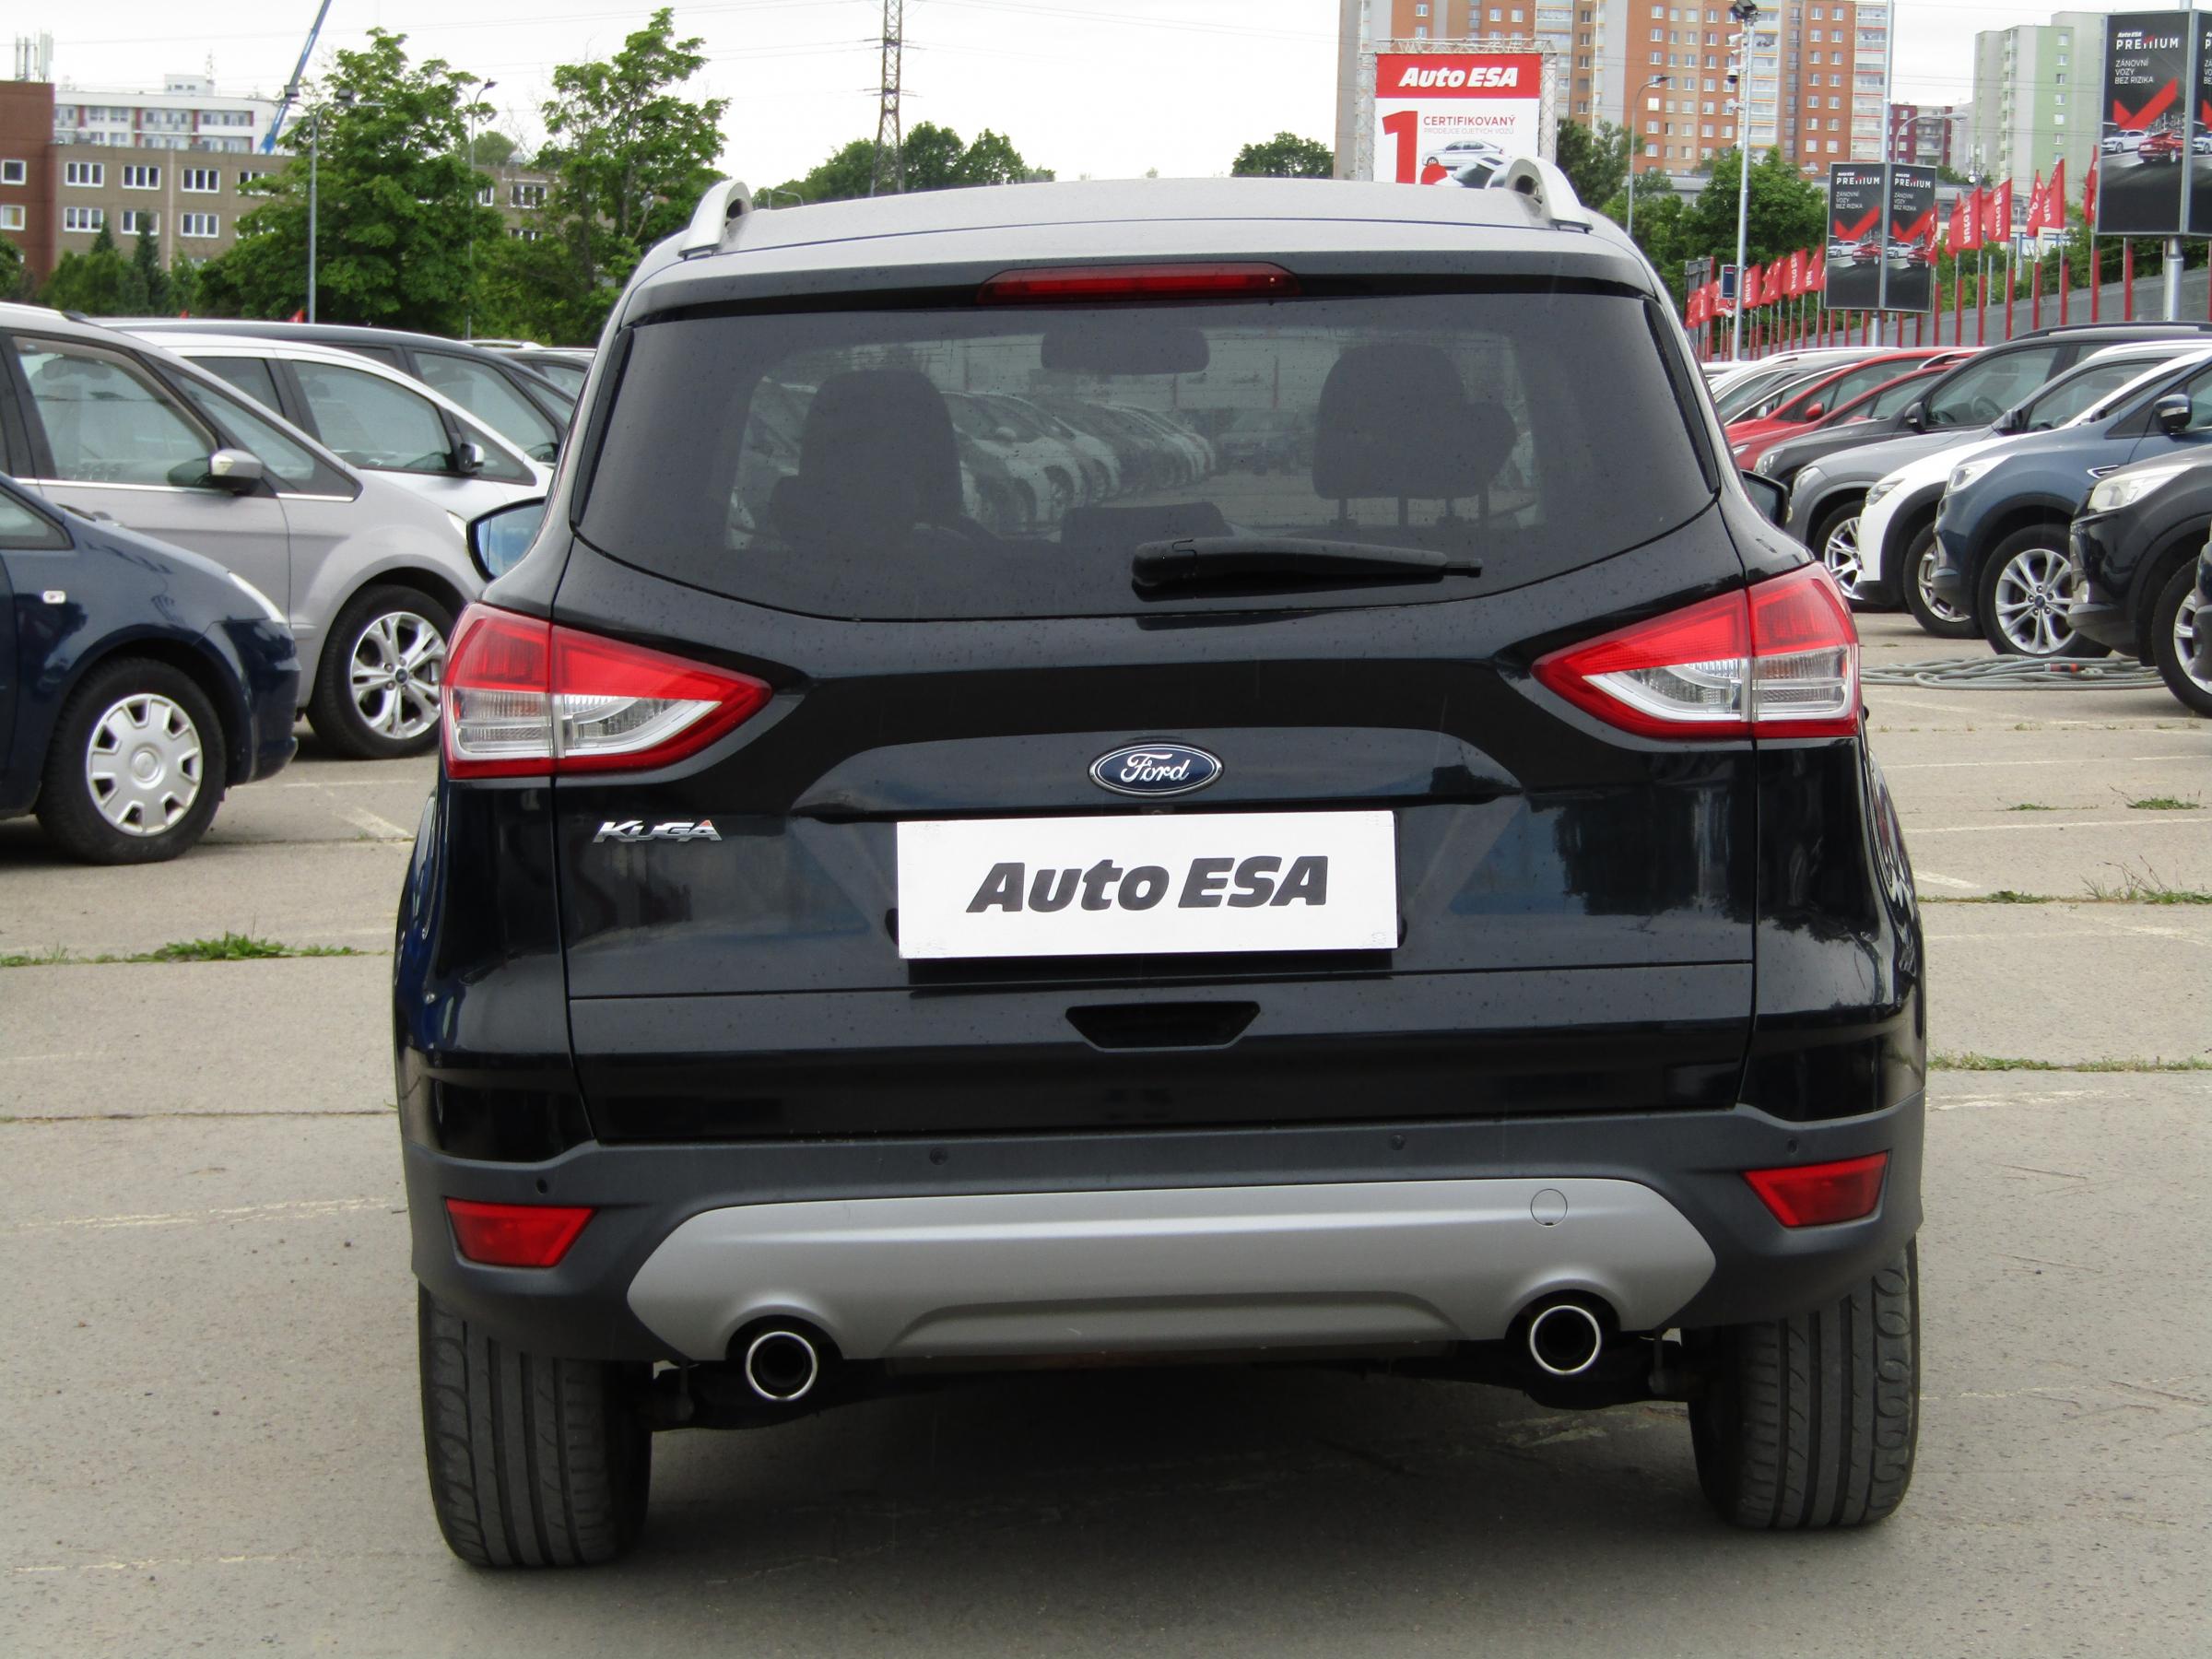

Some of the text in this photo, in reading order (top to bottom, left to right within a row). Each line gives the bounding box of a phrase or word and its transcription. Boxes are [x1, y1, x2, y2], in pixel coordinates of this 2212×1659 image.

[1398, 67, 1518, 88] Auto ESA
[2130, 76, 2154, 84] RIZIKA
[1423, 114, 1516, 126] CERTIFIKOVANÝ
[1120, 753, 1192, 783] Ford
[593, 819, 722, 842] KUGA
[966, 855, 1328, 912] Auto ESA
